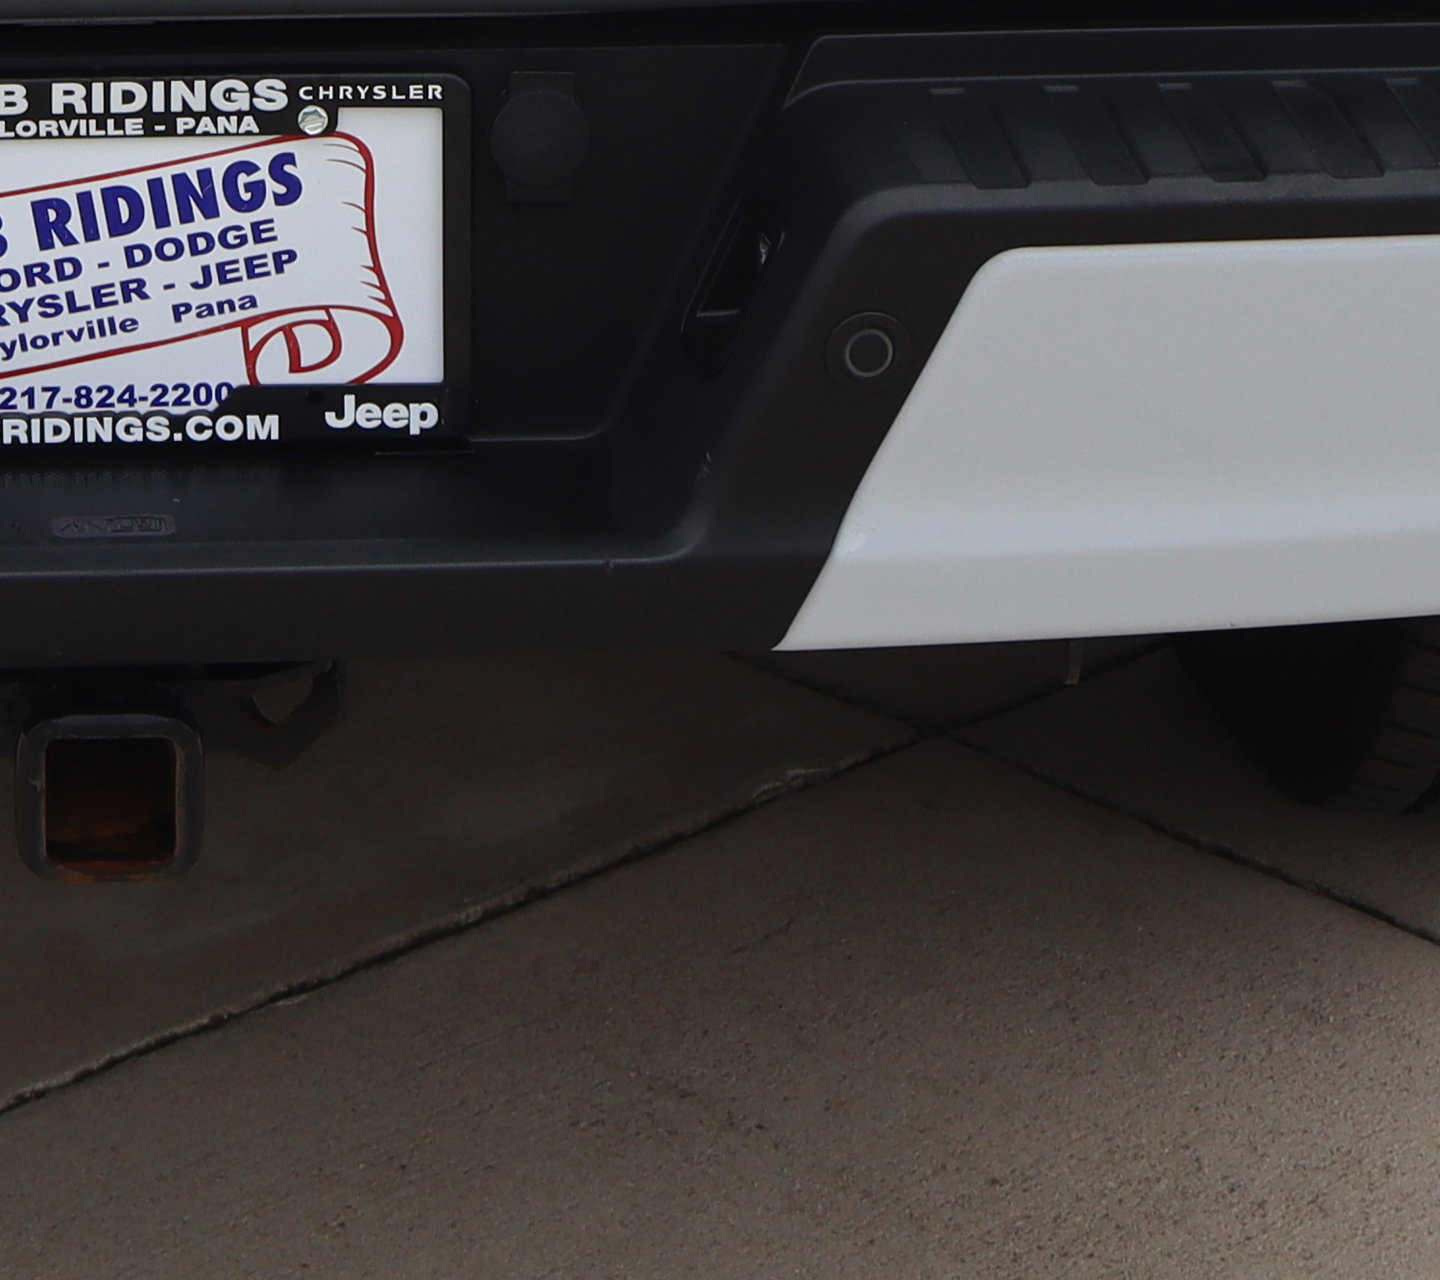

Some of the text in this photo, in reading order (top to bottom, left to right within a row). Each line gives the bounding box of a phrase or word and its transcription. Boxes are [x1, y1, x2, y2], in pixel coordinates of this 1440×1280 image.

[51, 78, 289, 115] RIDINGS
[298, 85, 444, 101] CHRYSLER
[176, 115, 260, 135] PANA
[30, 152, 303, 251] RIDINGS
[123, 218, 278, 269] DODGE
[189, 248, 298, 290] JEEP
[171, 293, 258, 324] Pana
[324, 394, 439, 436] Jeep
